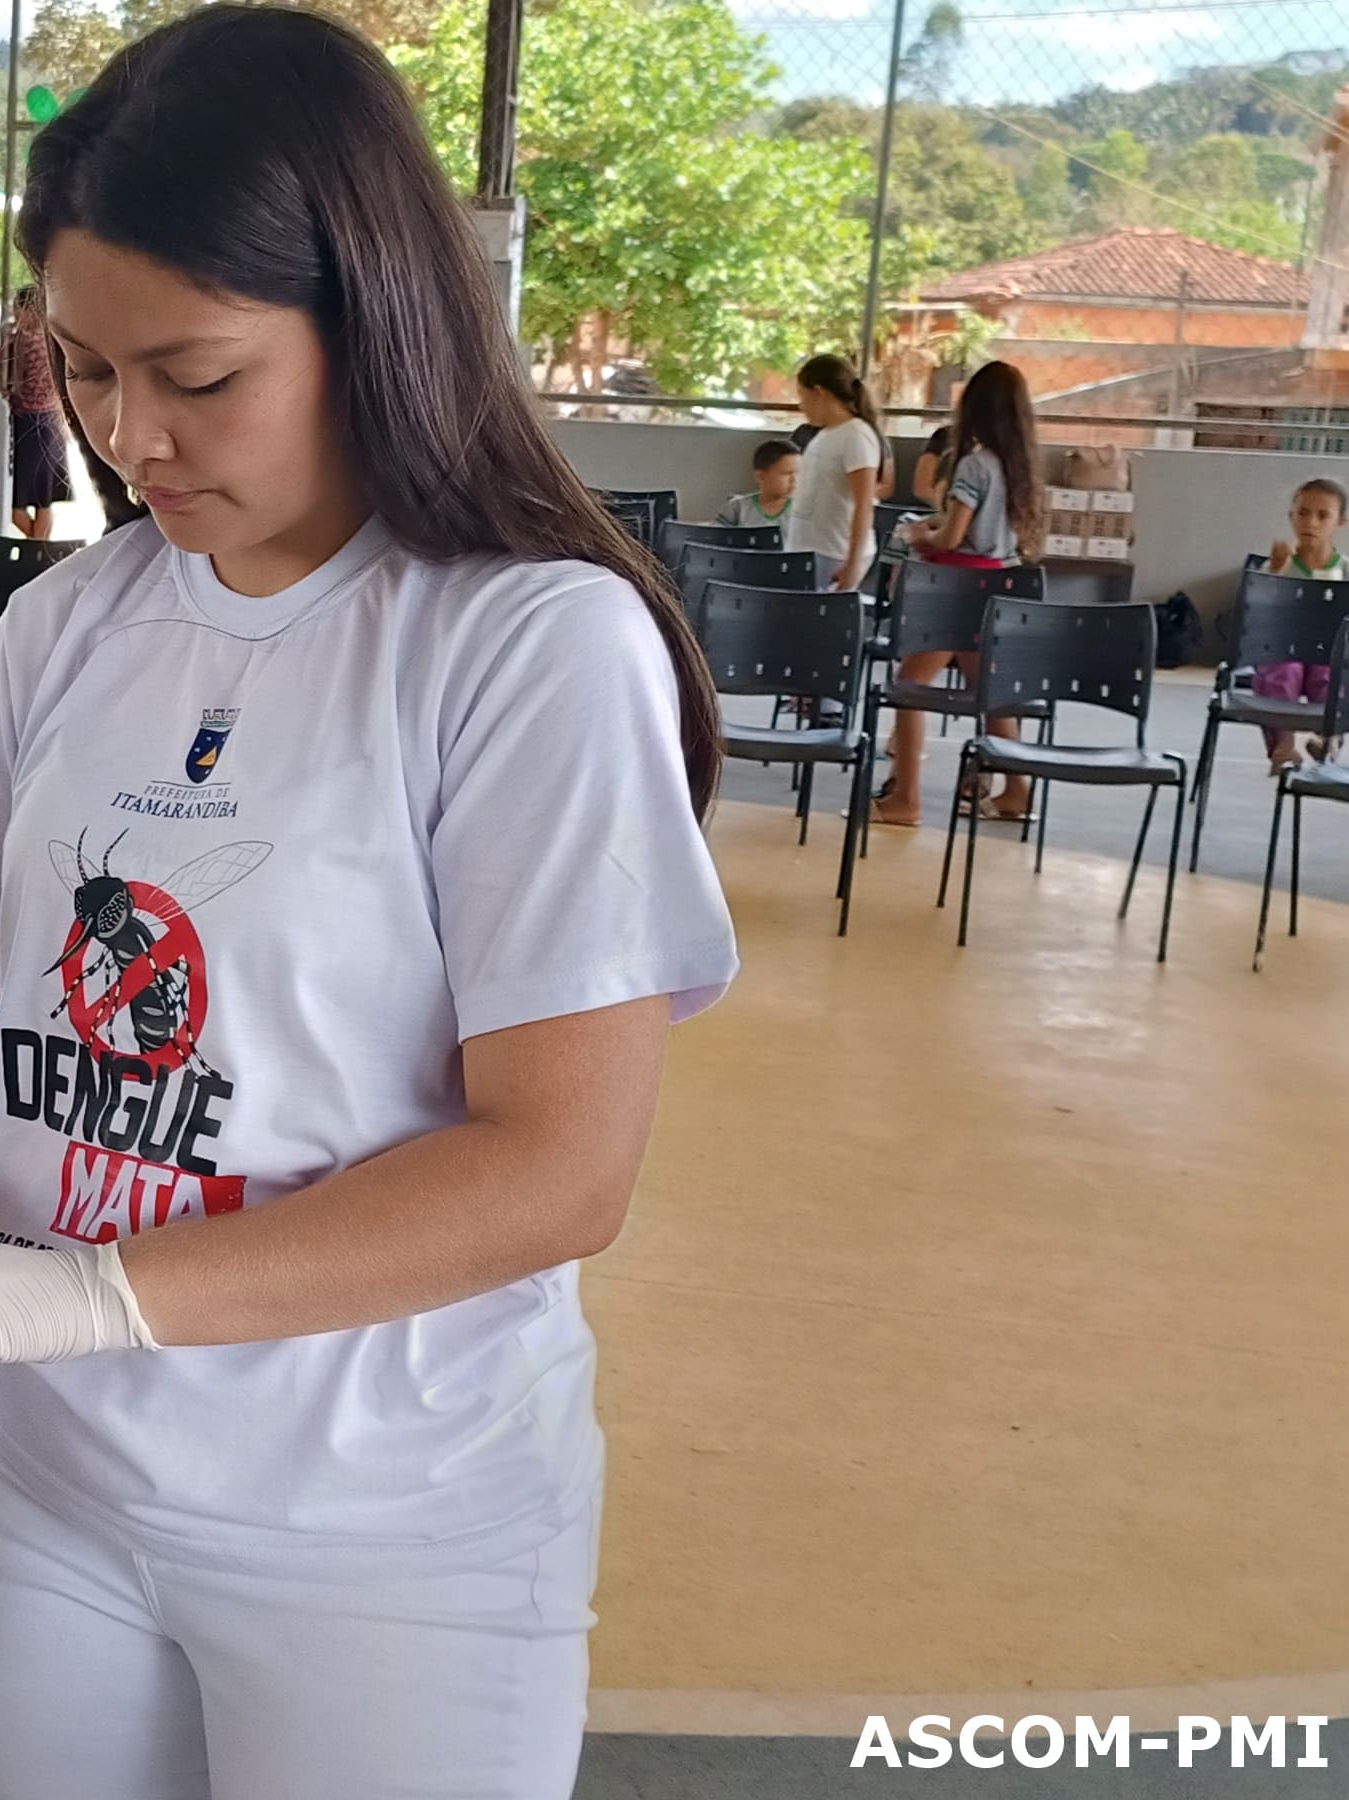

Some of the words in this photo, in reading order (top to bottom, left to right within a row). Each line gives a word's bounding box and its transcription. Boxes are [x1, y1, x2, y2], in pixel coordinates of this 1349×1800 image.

[110, 792, 238, 818] ITAMARANDIBA
[143, 785, 211, 800] PREFEITURA
[215, 787, 230, 798] DE
[1, 1028, 234, 1176] DENGUE
[57, 1147, 208, 1239] MATA
